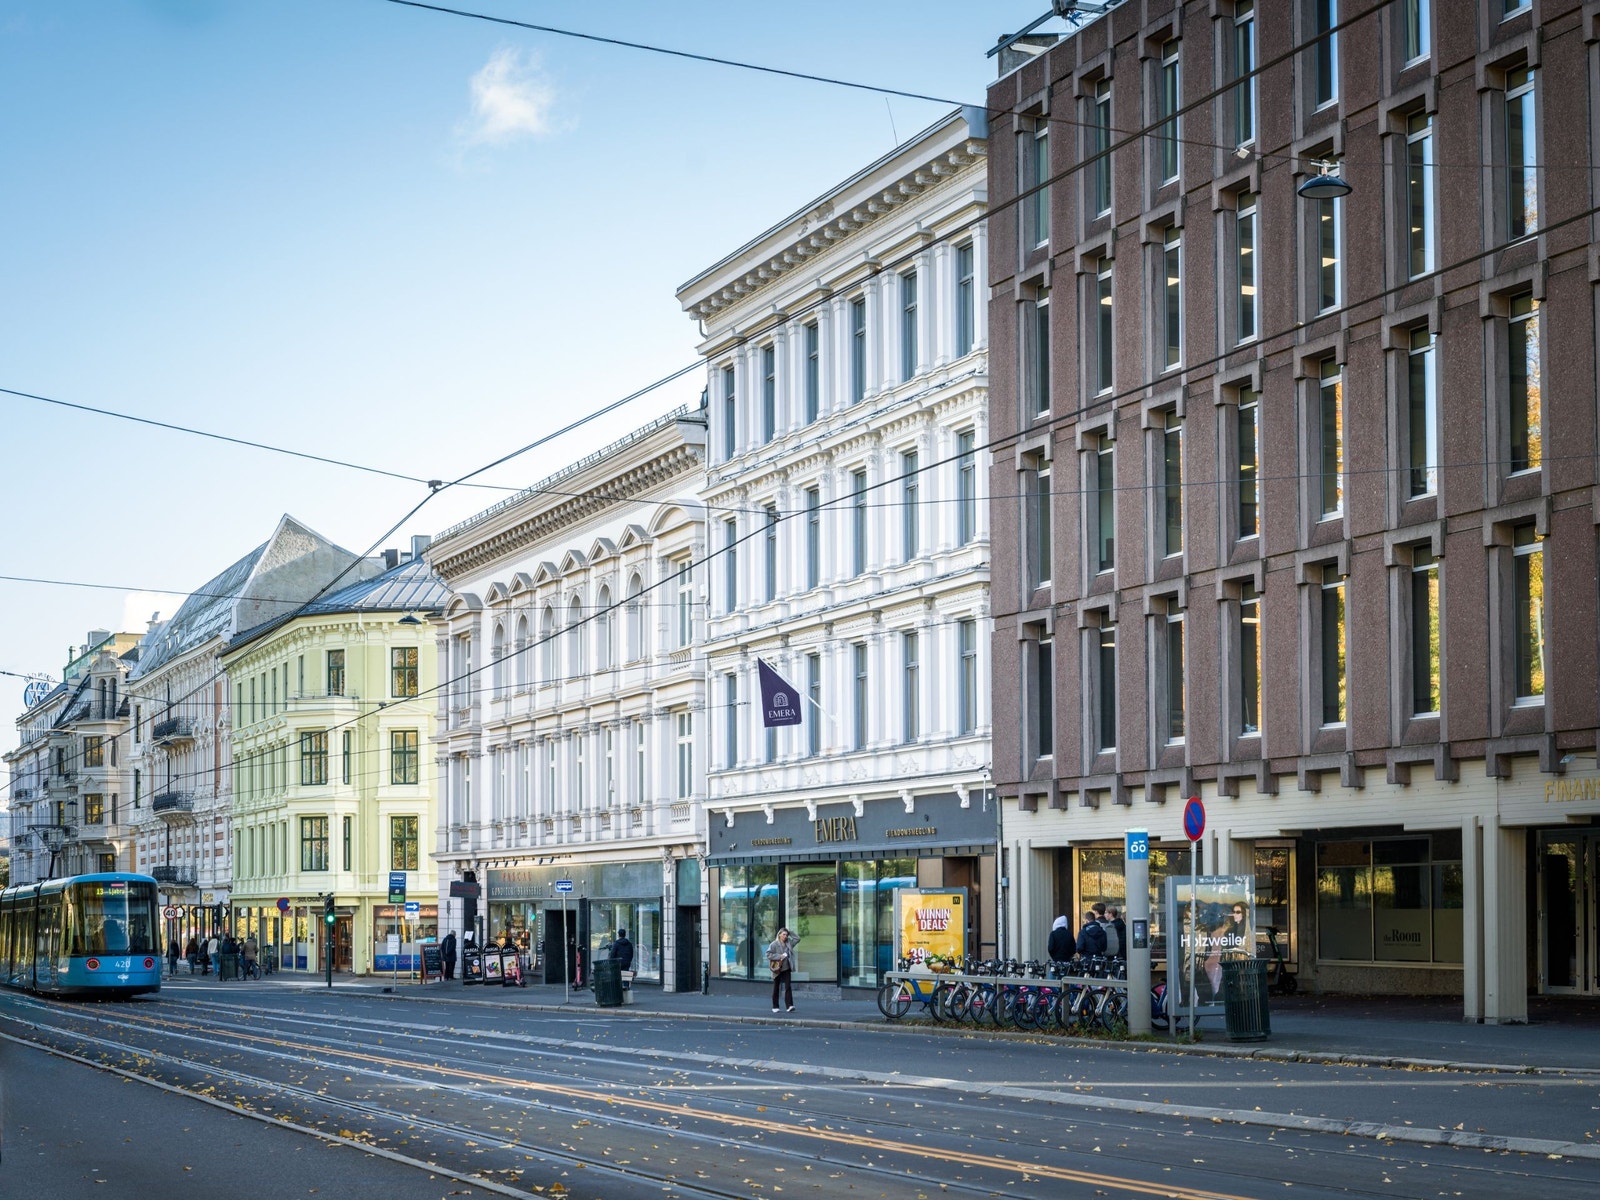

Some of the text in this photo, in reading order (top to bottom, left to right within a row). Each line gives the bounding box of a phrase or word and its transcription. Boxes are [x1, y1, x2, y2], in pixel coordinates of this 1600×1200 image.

[768, 709, 796, 719] EMERA
[814, 815, 857, 843] EMERA
[166, 908, 175, 917] 40
[919, 919, 948, 931] DEALS
[1181, 933, 1246, 947] Hlzweiler
[1391, 929, 1421, 942] Room
